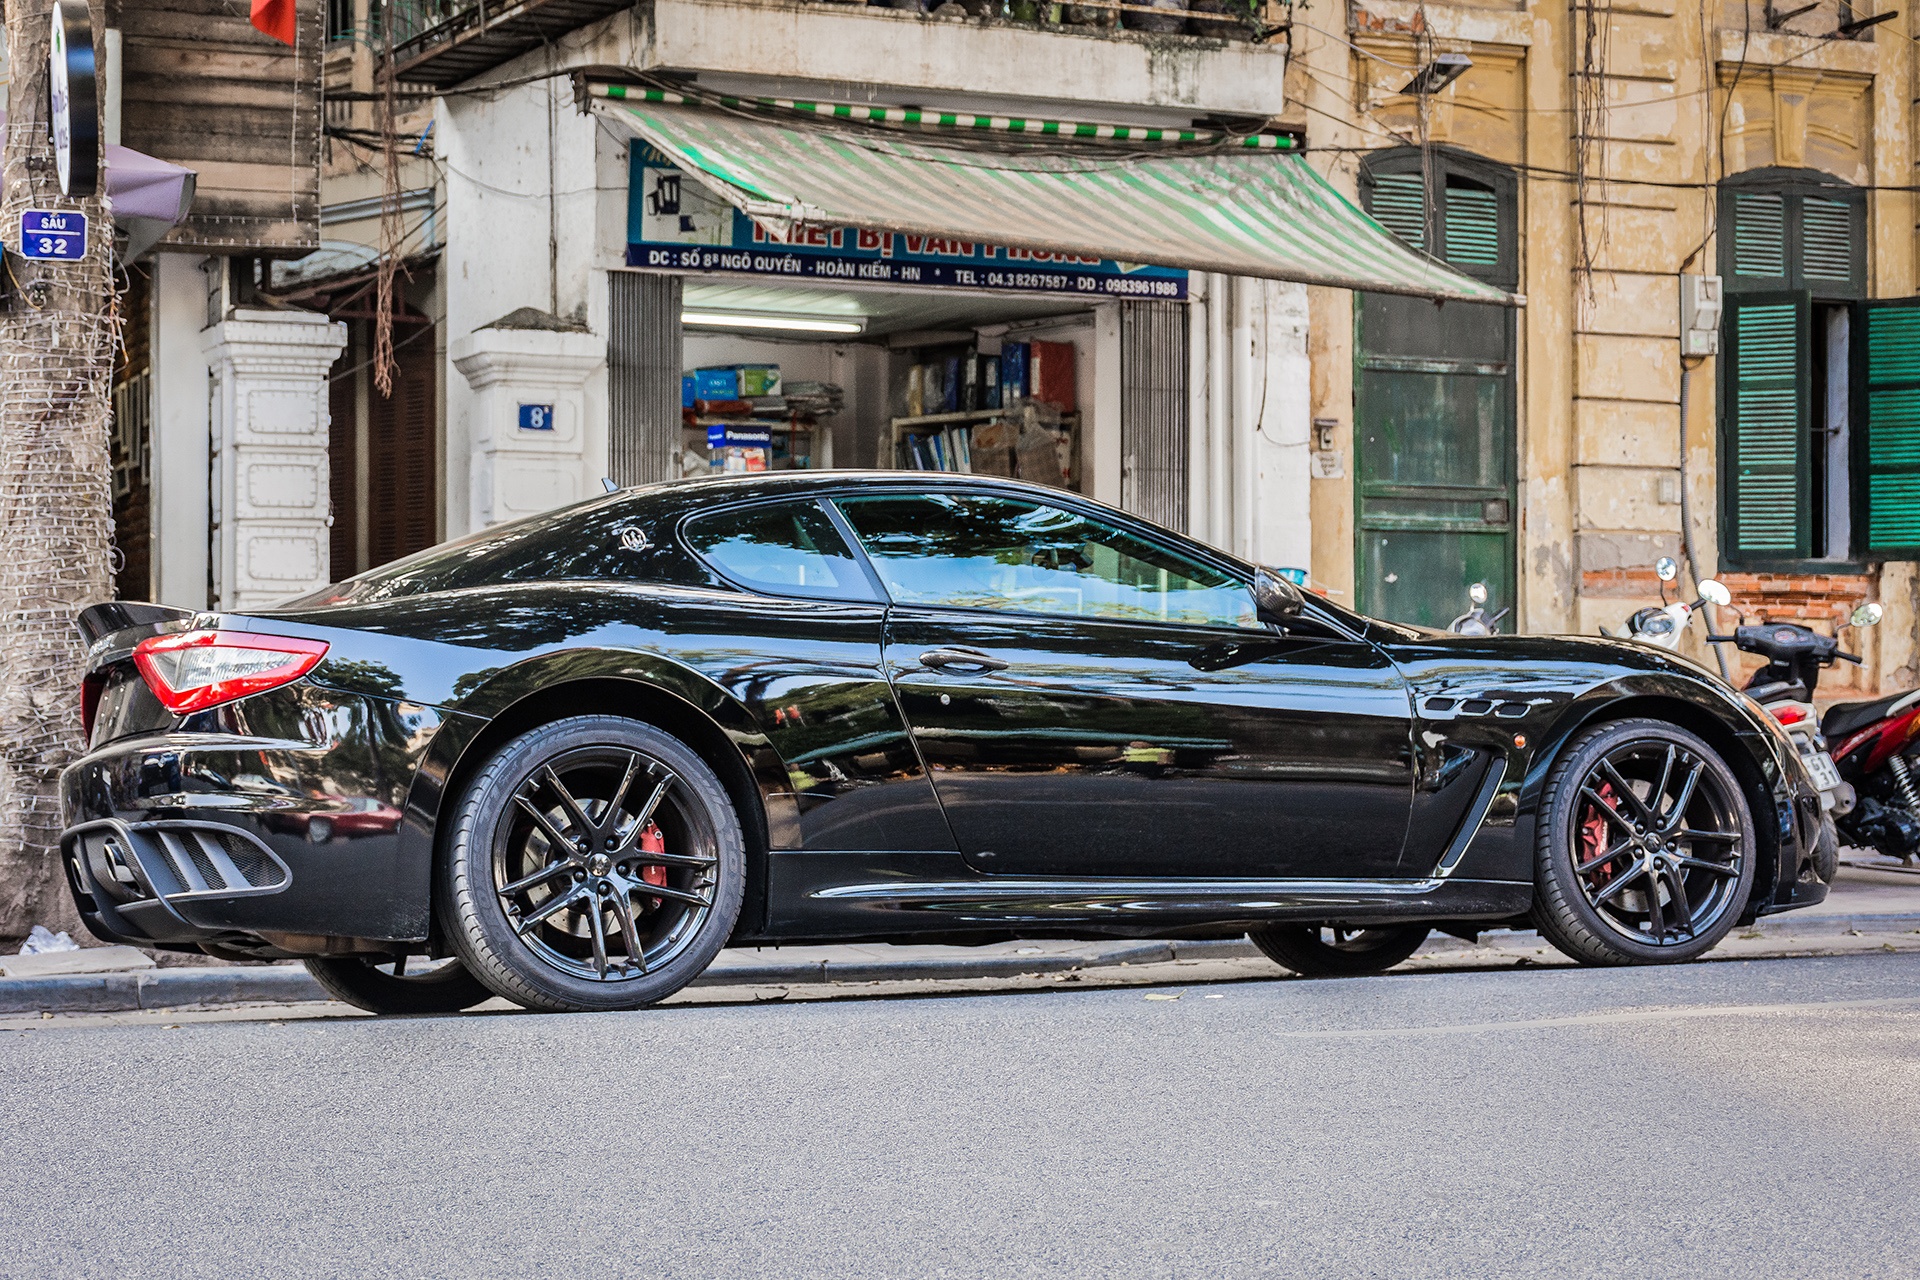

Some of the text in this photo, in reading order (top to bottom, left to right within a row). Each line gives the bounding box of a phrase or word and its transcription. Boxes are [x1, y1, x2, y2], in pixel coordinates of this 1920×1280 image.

[39, 237, 67, 255] 32
[720, 251, 751, 269] NGÔ
[815, 257, 855, 278] HOÀN
[858, 259, 892, 280] KIẾM
[901, 266, 921, 281] HN
[726, 430, 770, 442] Panasonic
